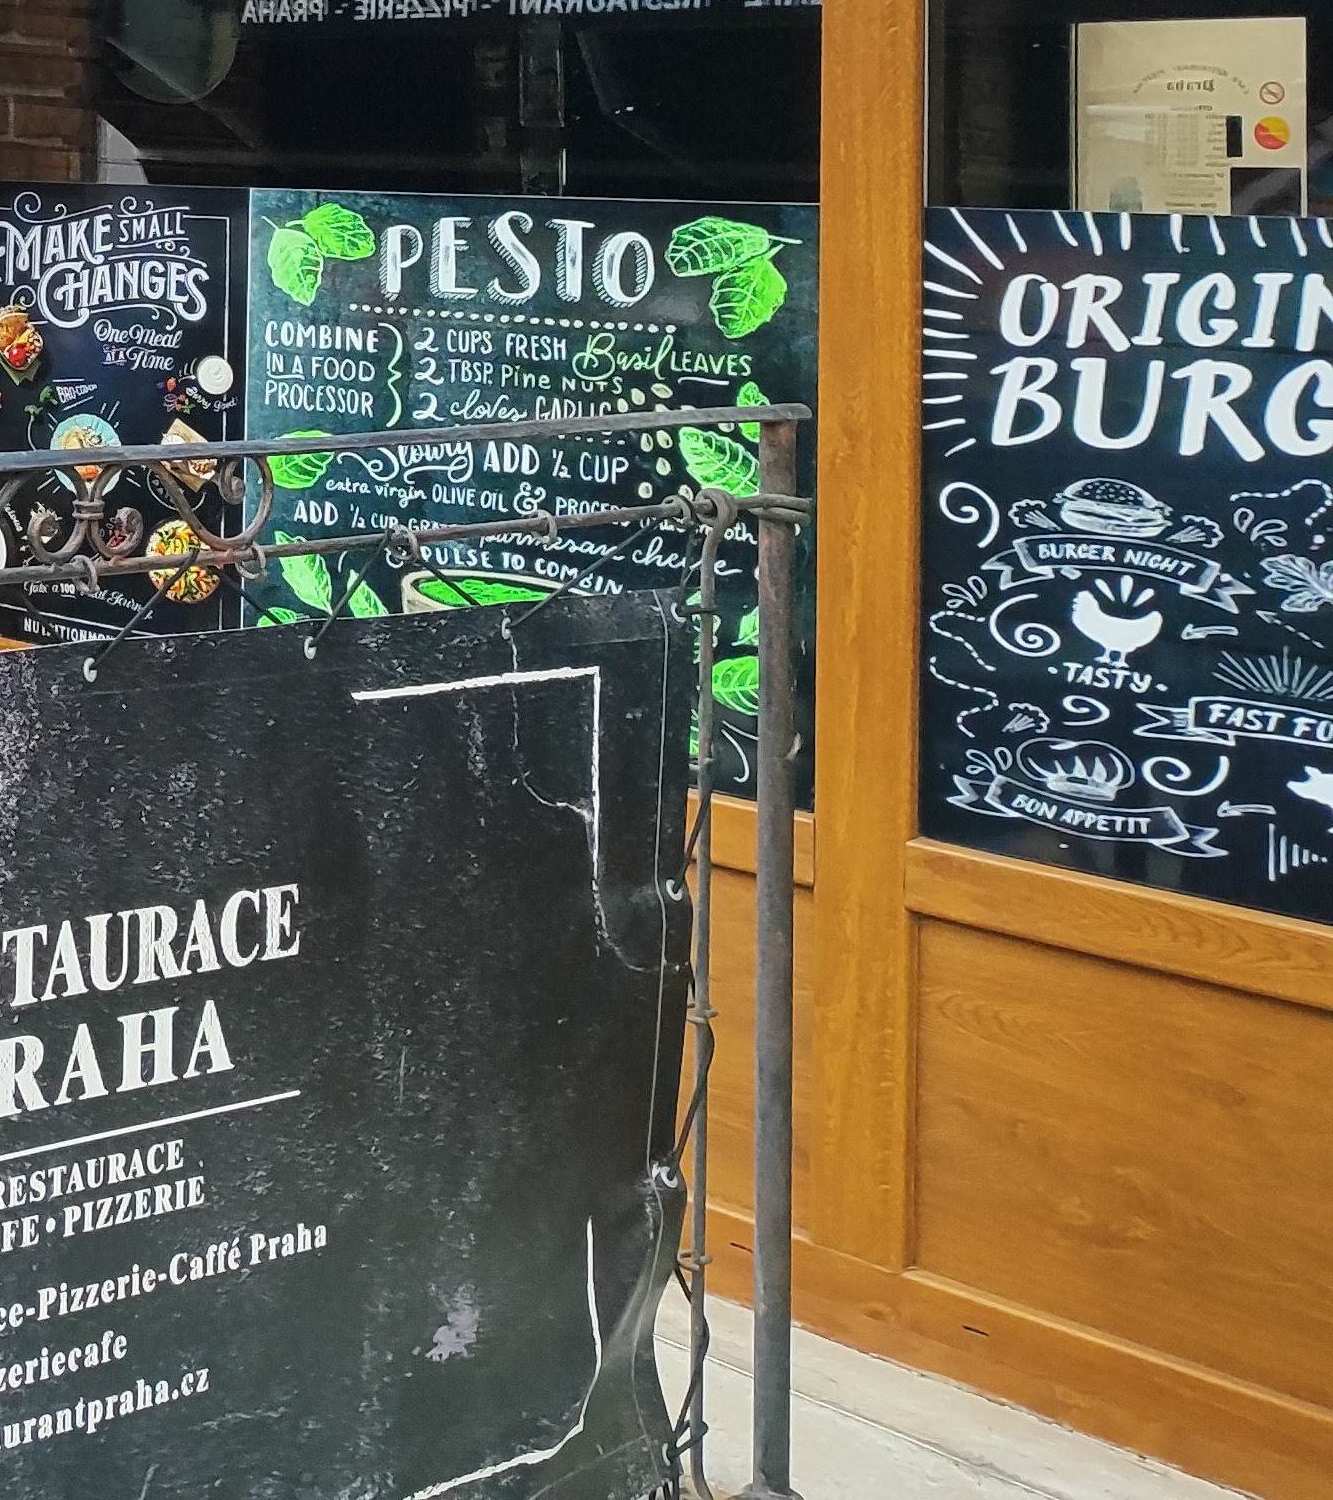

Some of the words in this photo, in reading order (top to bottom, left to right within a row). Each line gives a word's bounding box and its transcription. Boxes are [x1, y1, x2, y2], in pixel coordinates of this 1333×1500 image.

[119, 211, 186, 243] SMALL
[378, 210, 655, 308] PESTO
[37, 260, 210, 329] CHANGES
[93, 318, 130, 344] One
[130, 323, 183, 349] Meal
[264, 321, 379, 353] COMBINE
[127, 347, 175, 371] Time
[267, 352, 287, 375] IN
[289, 355, 304, 376] A
[312, 356, 375, 381] FOOD
[413, 327, 440, 354] 2
[446, 329, 493, 355] CUPS
[505, 332, 567, 362] FRESH
[572, 332, 674, 381] Basil
[670, 353, 753, 378] LEAVES
[413, 357, 445, 386] 2
[500, 366, 551, 391] Pine
[561, 375, 624, 394] NUTS
[264, 380, 374, 417] PROCESSOR
[412, 391, 445, 420] 2
[449, 391, 530, 425] cloves
[535, 395, 613, 422] GARLIC
[483, 444, 540, 474] ADD
[578, 457, 630, 486] CUP
[294, 500, 339, 526] ADD
[326, 479, 371, 496] extra
[375, 482, 426, 508] virgin
[431, 483, 476, 507] OLIVE
[480, 489, 508, 511] OIL
[512, 481, 547, 516] &
[421, 547, 490, 570] PULSE
[501, 552, 524, 572] TO
[534, 557, 624, 595] COMBIN
[1037, 543, 1115, 563] BURGER
[1123, 548, 1197, 577] NIGHT
[60, 582, 76, 595] 100
[1062, 661, 1153, 693] TASTY
[1207, 703, 1287, 732] FAST
[1011, 793, 1058, 820] BON
[1059, 809, 1152, 834] APPETIT
[63, 1175, 206, 1238] PIZZERIE
[249, 1220, 328, 1267] Praha
